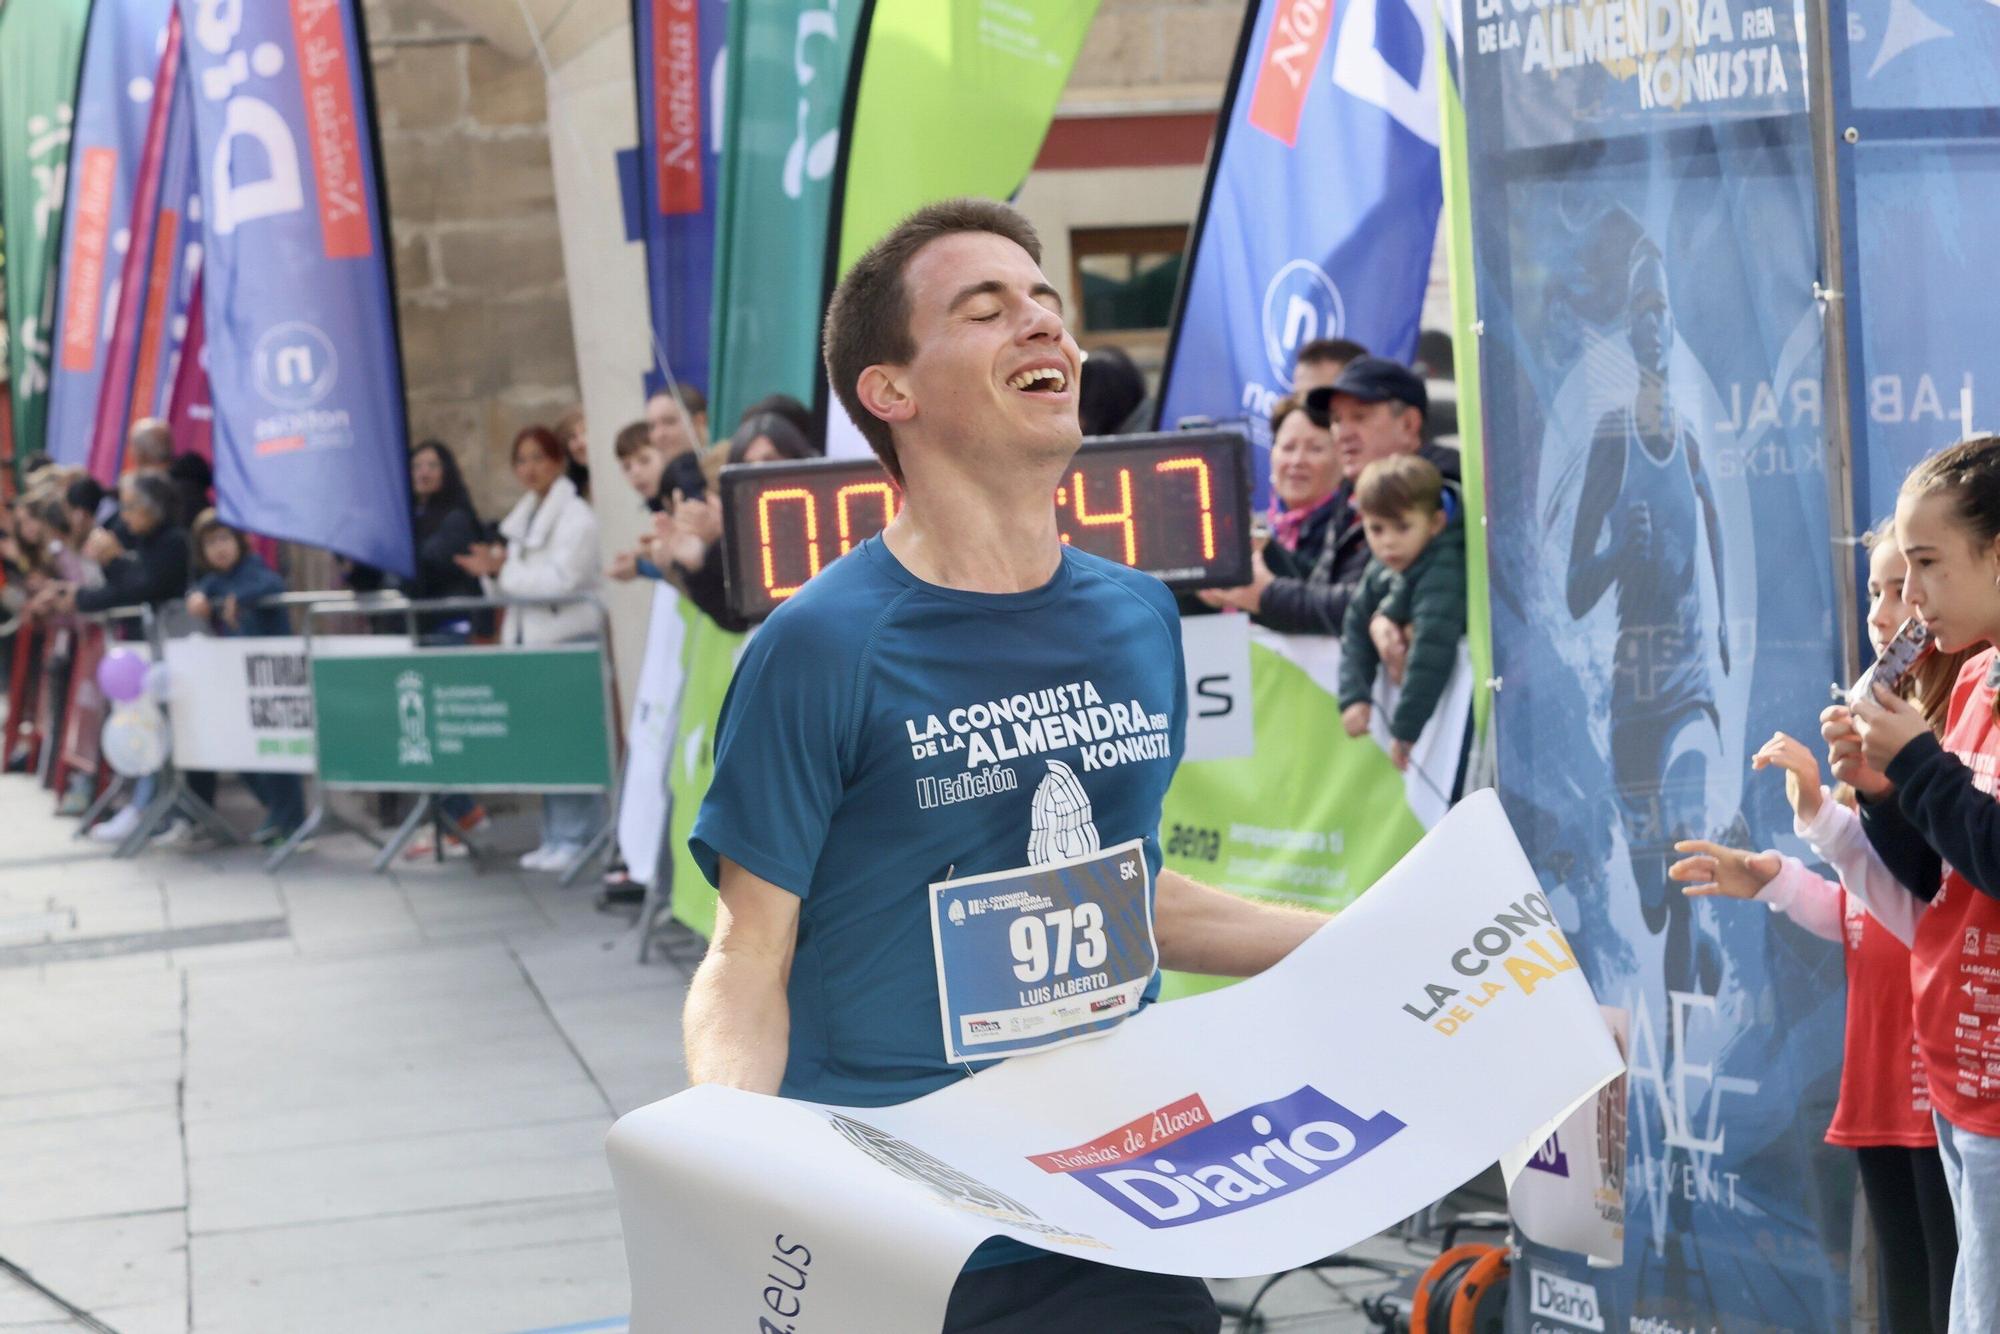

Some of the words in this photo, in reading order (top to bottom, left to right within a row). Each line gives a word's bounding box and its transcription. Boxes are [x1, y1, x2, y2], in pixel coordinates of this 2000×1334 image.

[1477, 24, 1498, 54] DE
[1499, 20, 1521, 49] LA
[1523, 0, 1733, 73] ALMENDRA
[1742, 6, 1775, 40] REN
[1639, 44, 1788, 110] KONKISTA
[905, 715, 948, 744] LA
[948, 680, 1102, 733] CONQUISTA
[912, 742, 938, 760] DE
[941, 736, 967, 752] LA
[967, 700, 1151, 768] ALMENDRA
[1149, 713, 1169, 731] REN
[1080, 732, 1171, 772] KONKISTA
[938, 764, 1018, 805] Edición
[1119, 861, 1138, 881] 5K
[1009, 902, 1108, 983] 973
[1019, 986, 1051, 1007] LUIS
[1053, 973, 1109, 999] ALBERTO
[1402, 984, 1460, 1022] LA
[1433, 1005, 1474, 1037] DE
[1465, 981, 1506, 1008] LA
[1048, 1143, 1122, 1170] Noticias
[1124, 1128, 1146, 1153] de
[1150, 1103, 1205, 1143] Álava
[1096, 1114, 1357, 1221] Diario
[1538, 1276, 1594, 1321] Diario
